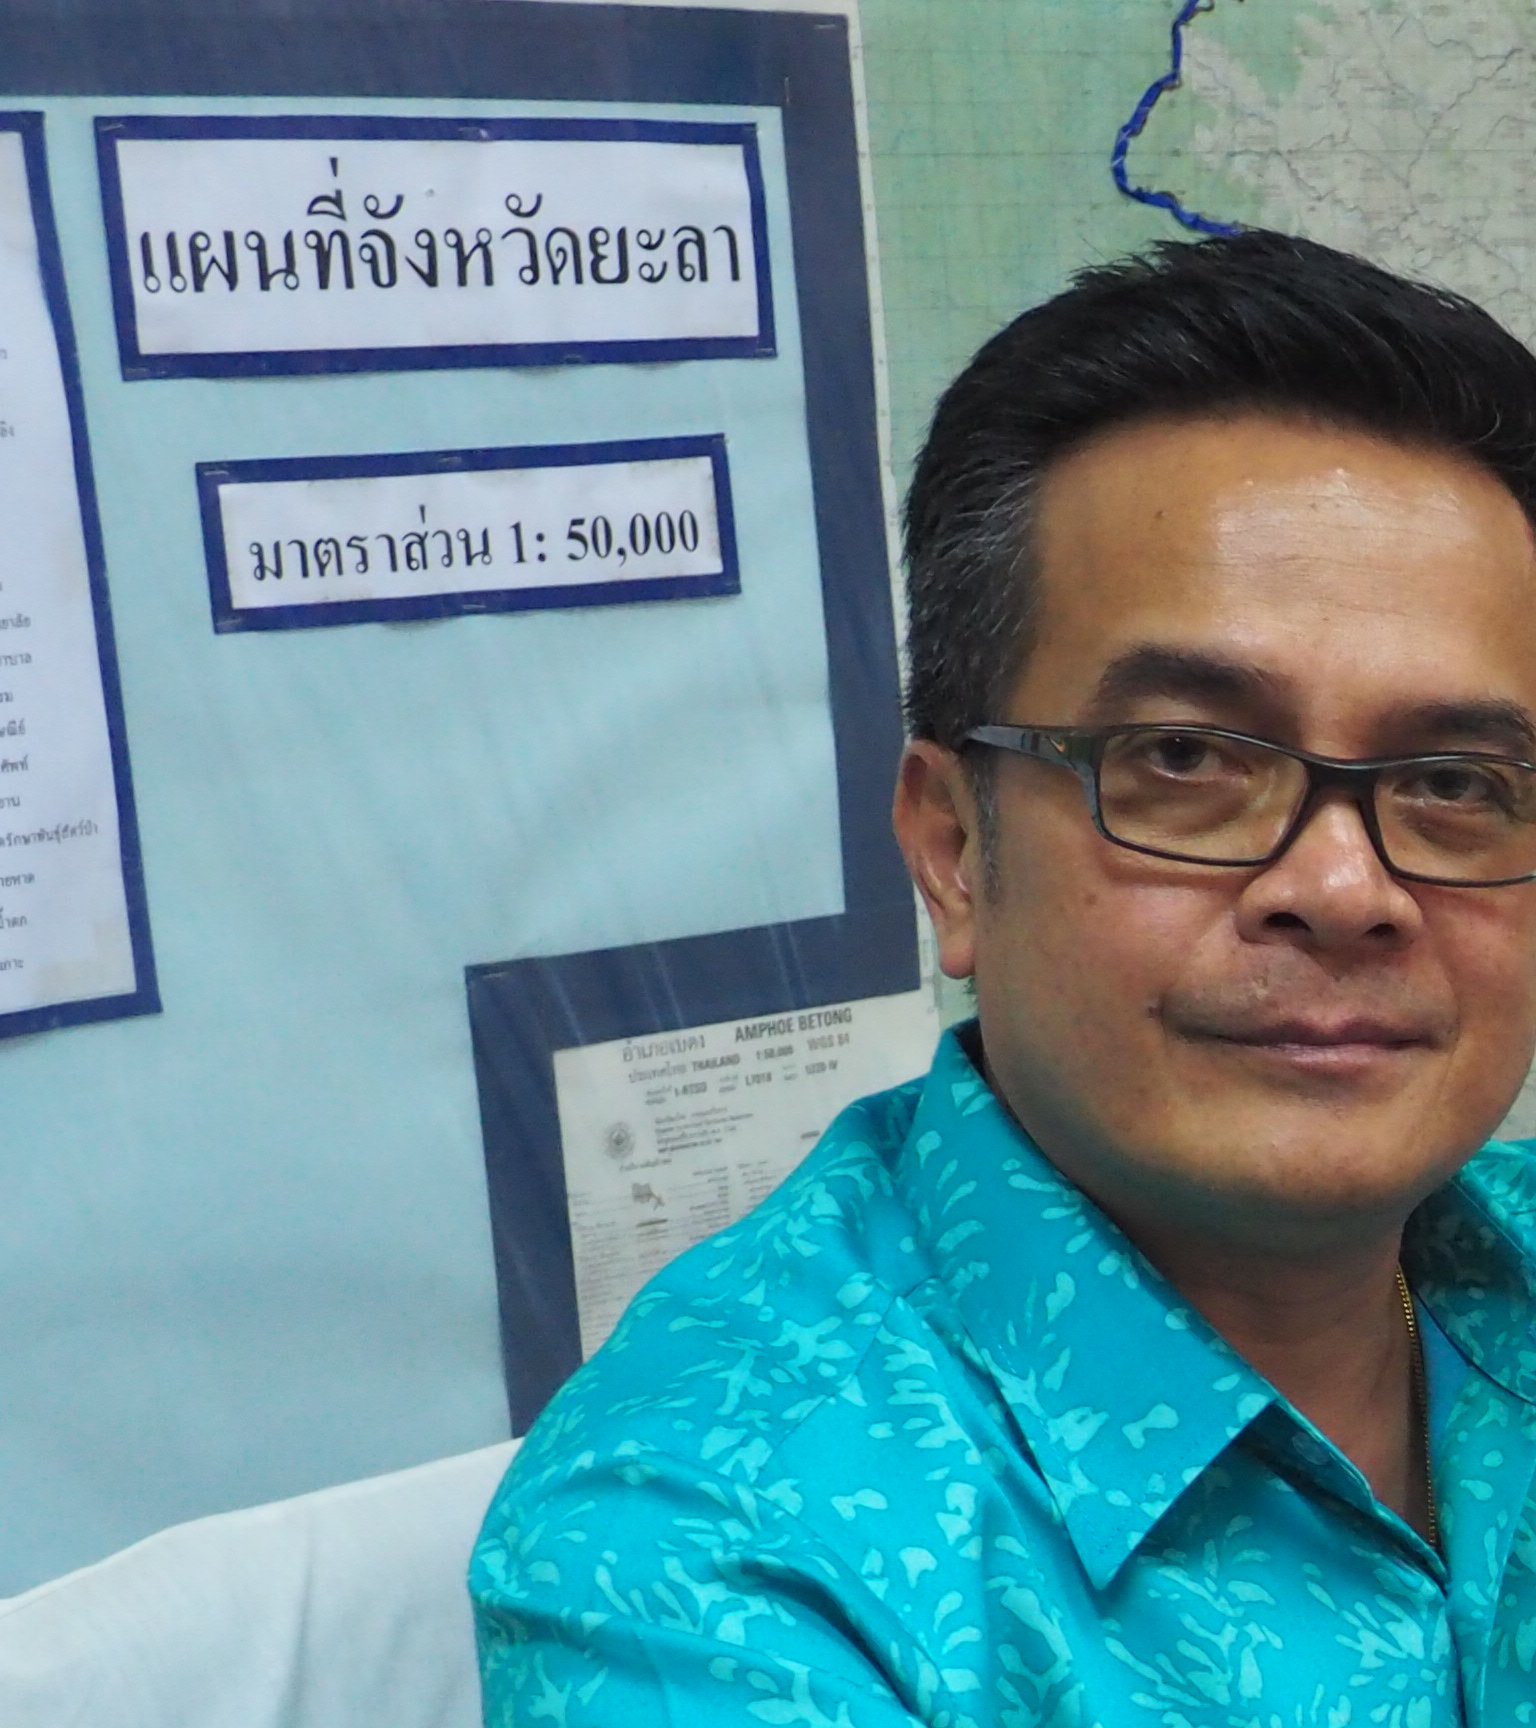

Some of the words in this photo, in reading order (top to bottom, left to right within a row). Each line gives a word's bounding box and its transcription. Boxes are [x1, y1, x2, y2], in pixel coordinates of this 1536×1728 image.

[139, 158, 742, 293] แผนที่จังหวัดยะลา
[250, 505, 493, 582] มาตราส่วน
[567, 509, 701, 566] 50,000
[734, 1016, 795, 1043] AMPHOE
[799, 1008, 853, 1032] BETONG
